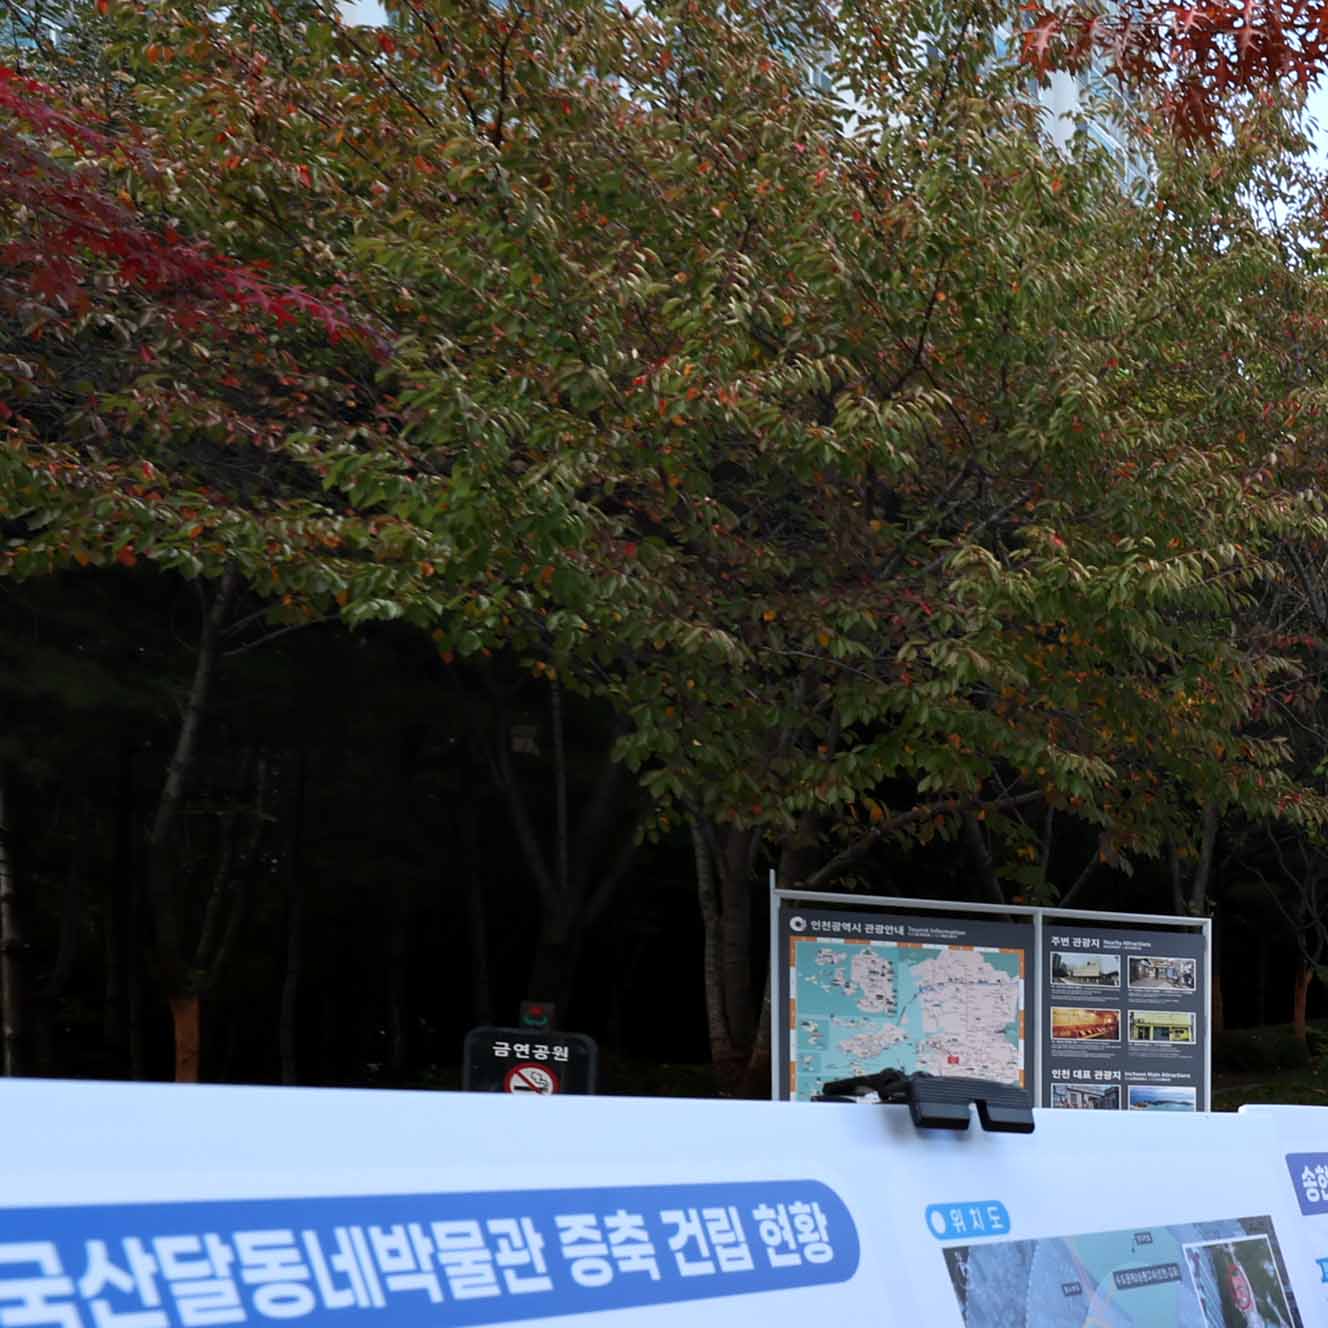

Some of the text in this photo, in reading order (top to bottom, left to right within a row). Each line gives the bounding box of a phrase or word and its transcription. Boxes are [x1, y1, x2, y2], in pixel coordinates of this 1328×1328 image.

[810, 919, 862, 934] 인천광역시
[864, 923, 904, 936] 관광안내
[1051, 935, 1100, 949] 주변 관광지
[492, 1041, 569, 1062] 금연공원
[1051, 1069, 1070, 1079] 인천
[1094, 1069, 1121, 1081] 관광지
[949, 1205, 1004, 1234] 위치도
[560, 1210, 663, 1286] 증축
[659, 1205, 747, 1278] 건립
[751, 1202, 836, 1270] 현황
